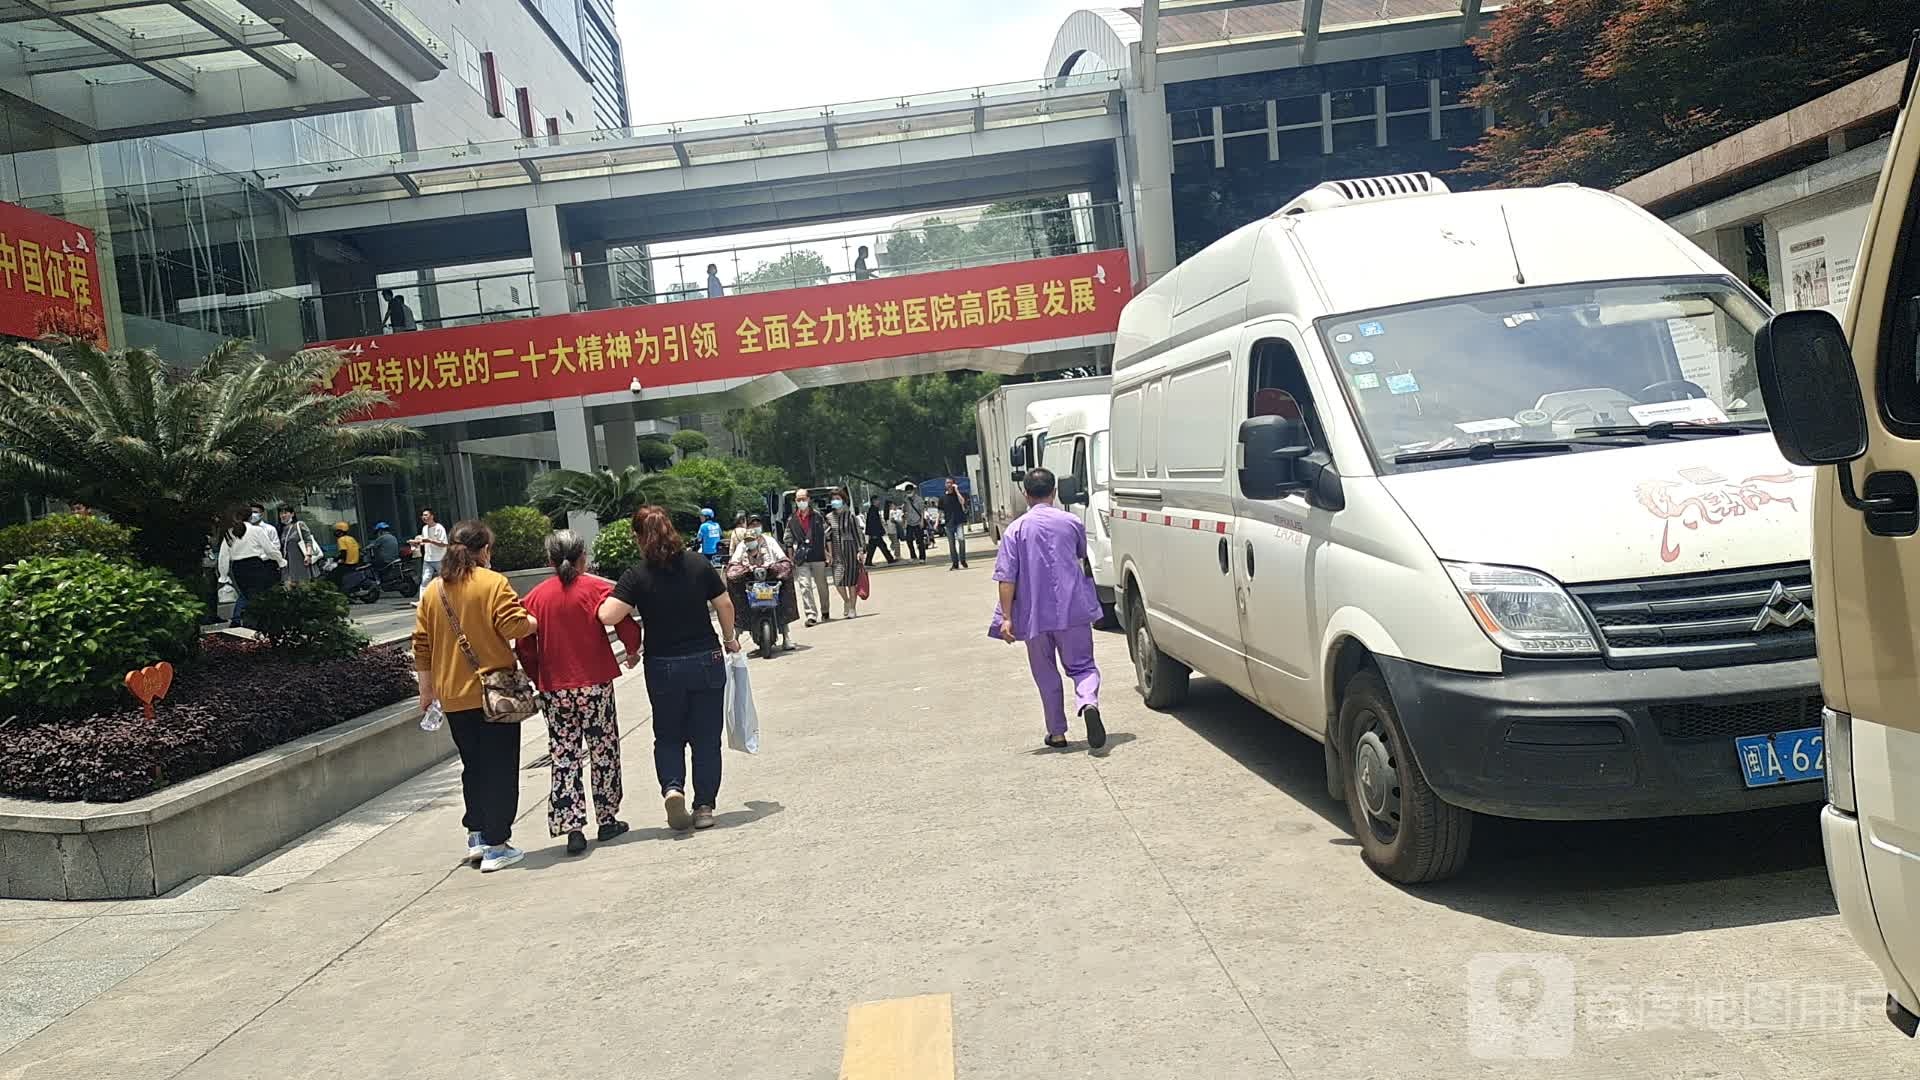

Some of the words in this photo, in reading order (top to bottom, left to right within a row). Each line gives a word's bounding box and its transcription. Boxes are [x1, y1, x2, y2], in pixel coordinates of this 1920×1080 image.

[348, 321, 719, 394] 坚持以党的二十大精神为引领
[735, 276, 1096, 355] 全面全力推进医院高质量发展
